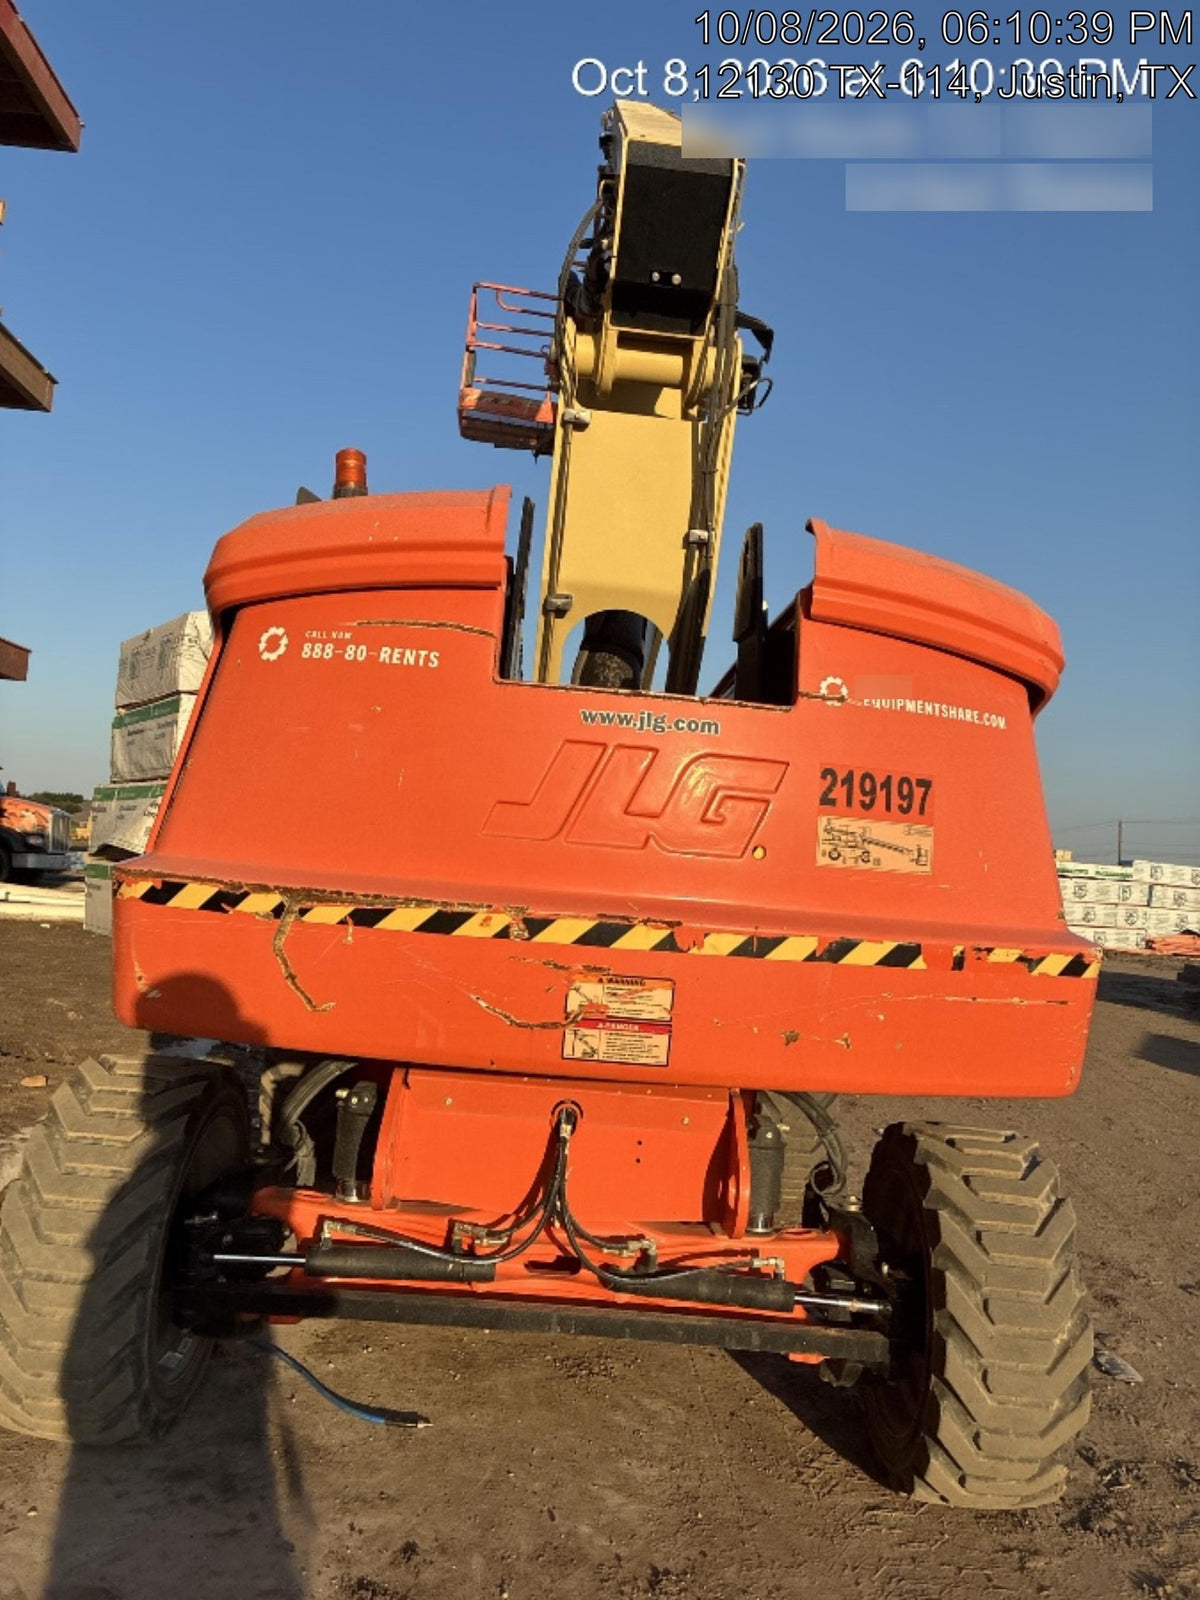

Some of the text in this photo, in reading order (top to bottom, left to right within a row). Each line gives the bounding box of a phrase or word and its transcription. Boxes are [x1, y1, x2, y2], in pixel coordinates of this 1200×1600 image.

[301, 642, 440, 668] 888-80-RENTS
[580, 708, 720, 735] www.jlg.com
[481, 739, 789, 860] JLG
[819, 767, 933, 816] 219197
